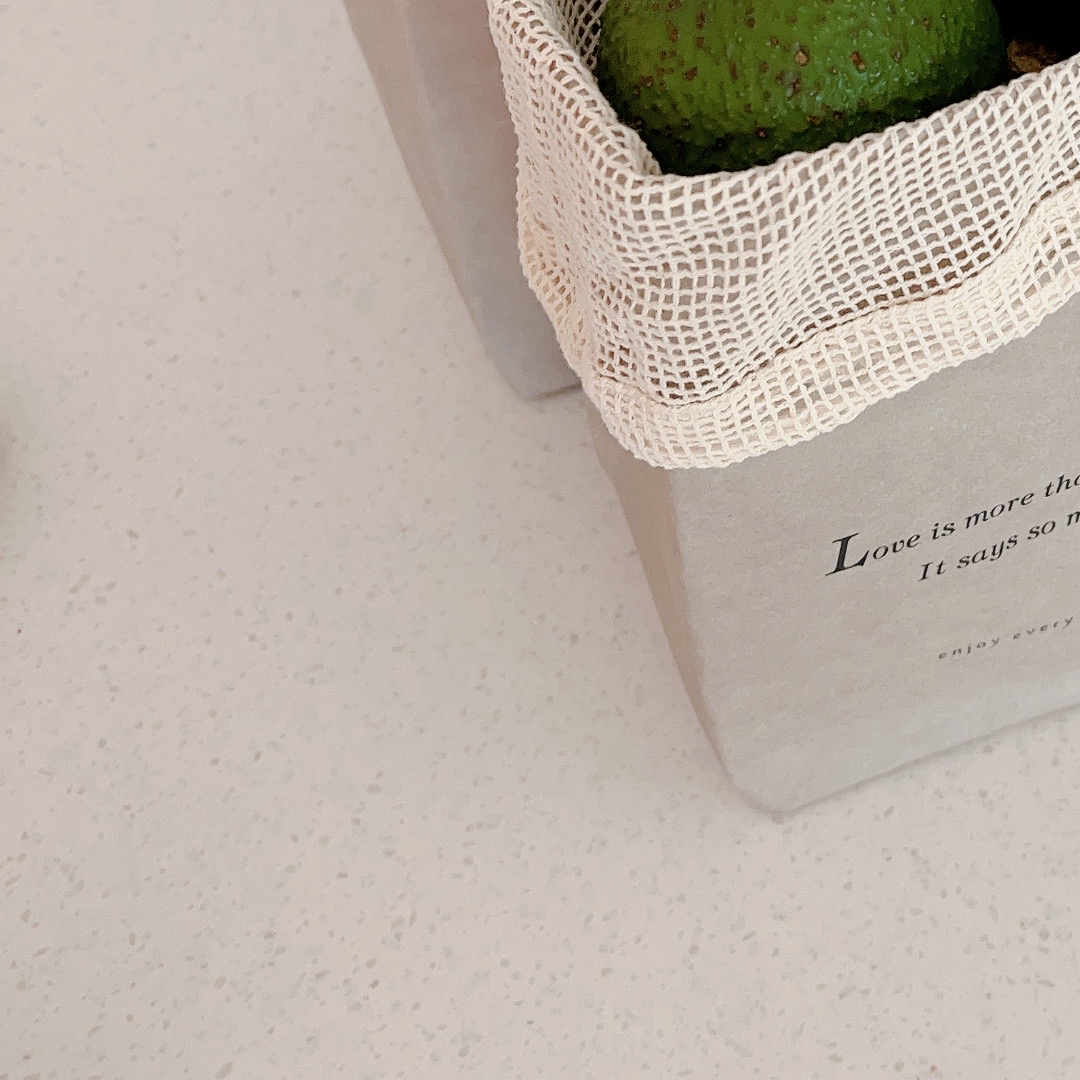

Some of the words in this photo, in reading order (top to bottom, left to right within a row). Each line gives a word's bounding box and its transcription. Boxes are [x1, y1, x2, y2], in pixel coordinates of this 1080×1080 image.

[825, 532, 920, 577] Love
[932, 522, 956, 541] is
[965, 489, 1035, 530] more
[918, 561, 947, 582] It
[957, 532, 1019, 570] says
[1027, 519, 1057, 541] so
[938, 637, 1000, 659] enjoy
[1013, 615, 1074, 640] every
